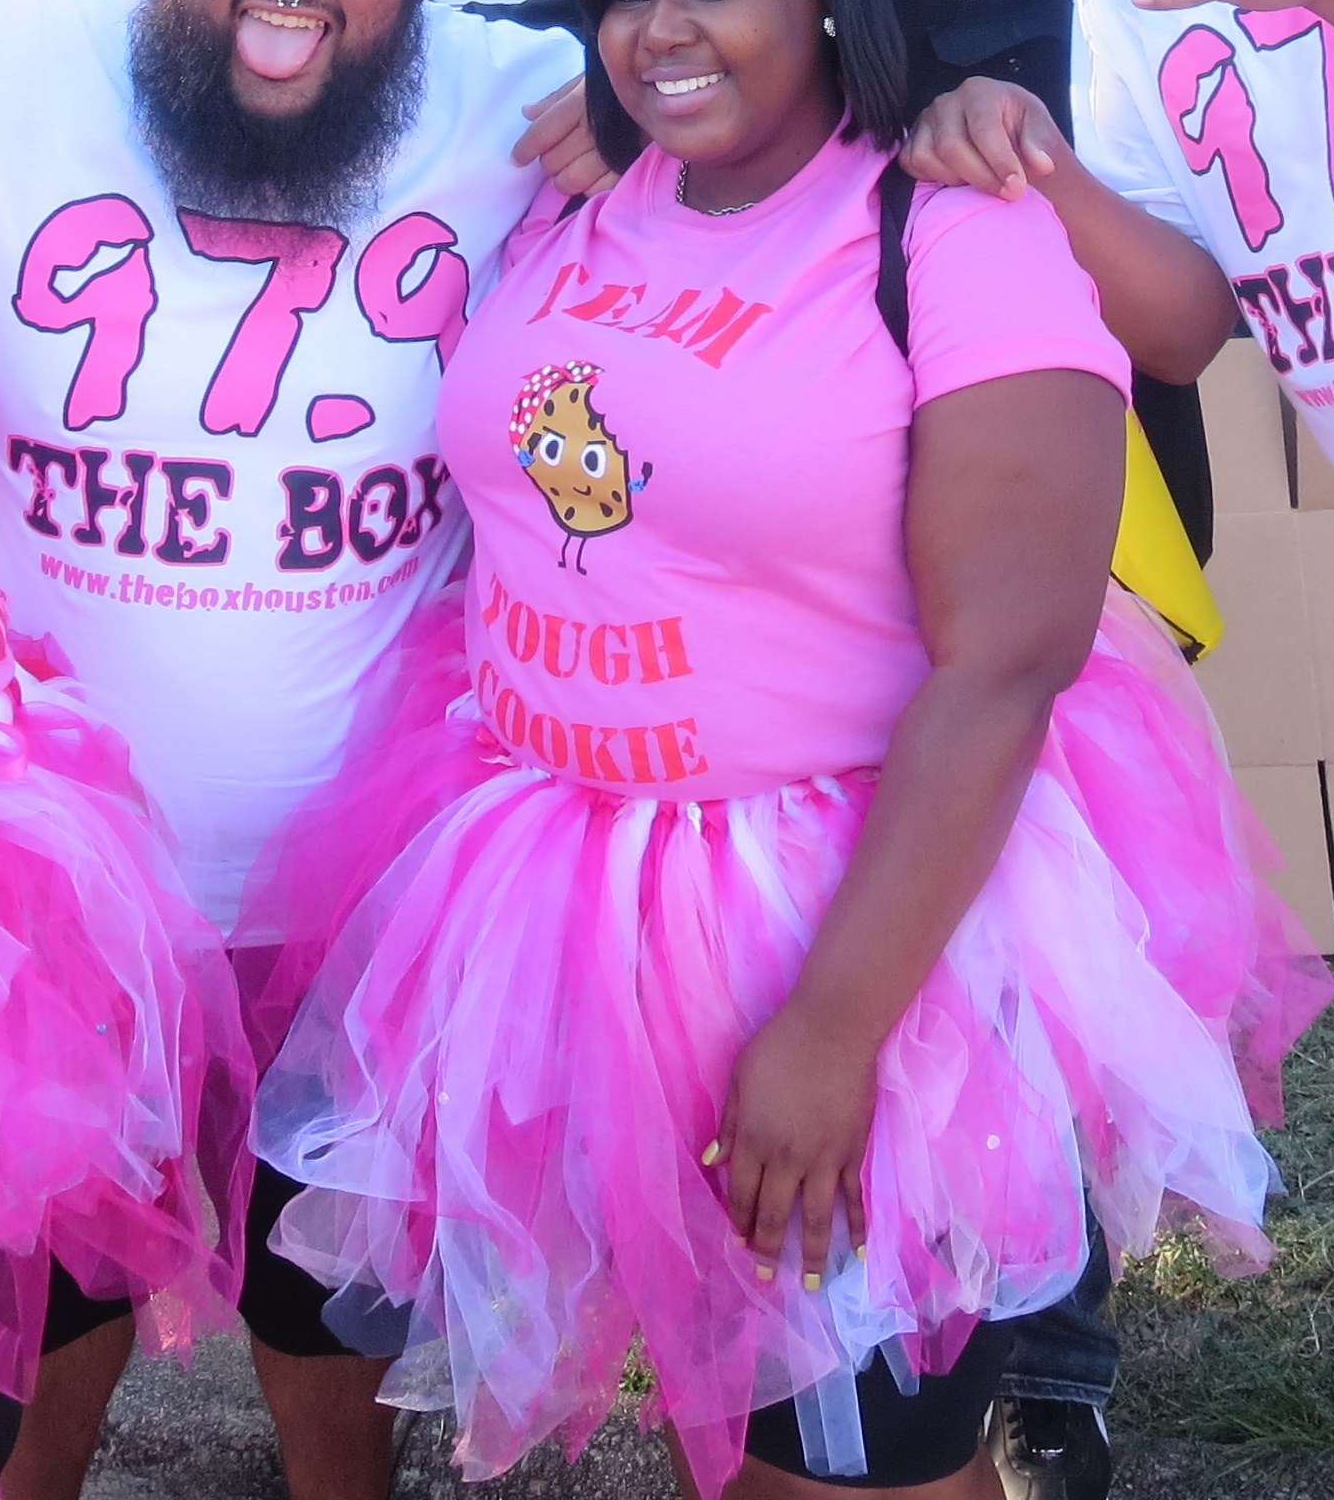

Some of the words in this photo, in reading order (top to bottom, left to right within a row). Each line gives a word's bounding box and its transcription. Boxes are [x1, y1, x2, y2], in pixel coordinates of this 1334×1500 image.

[526, 261, 774, 369] TEAM
[7, 435, 234, 567] THE
[276, 453, 450, 573] BOX
[40, 553, 419, 614] www.theboxhouston.com
[481, 572, 694, 686] TOUGH
[476, 659, 709, 784] COOKIE
